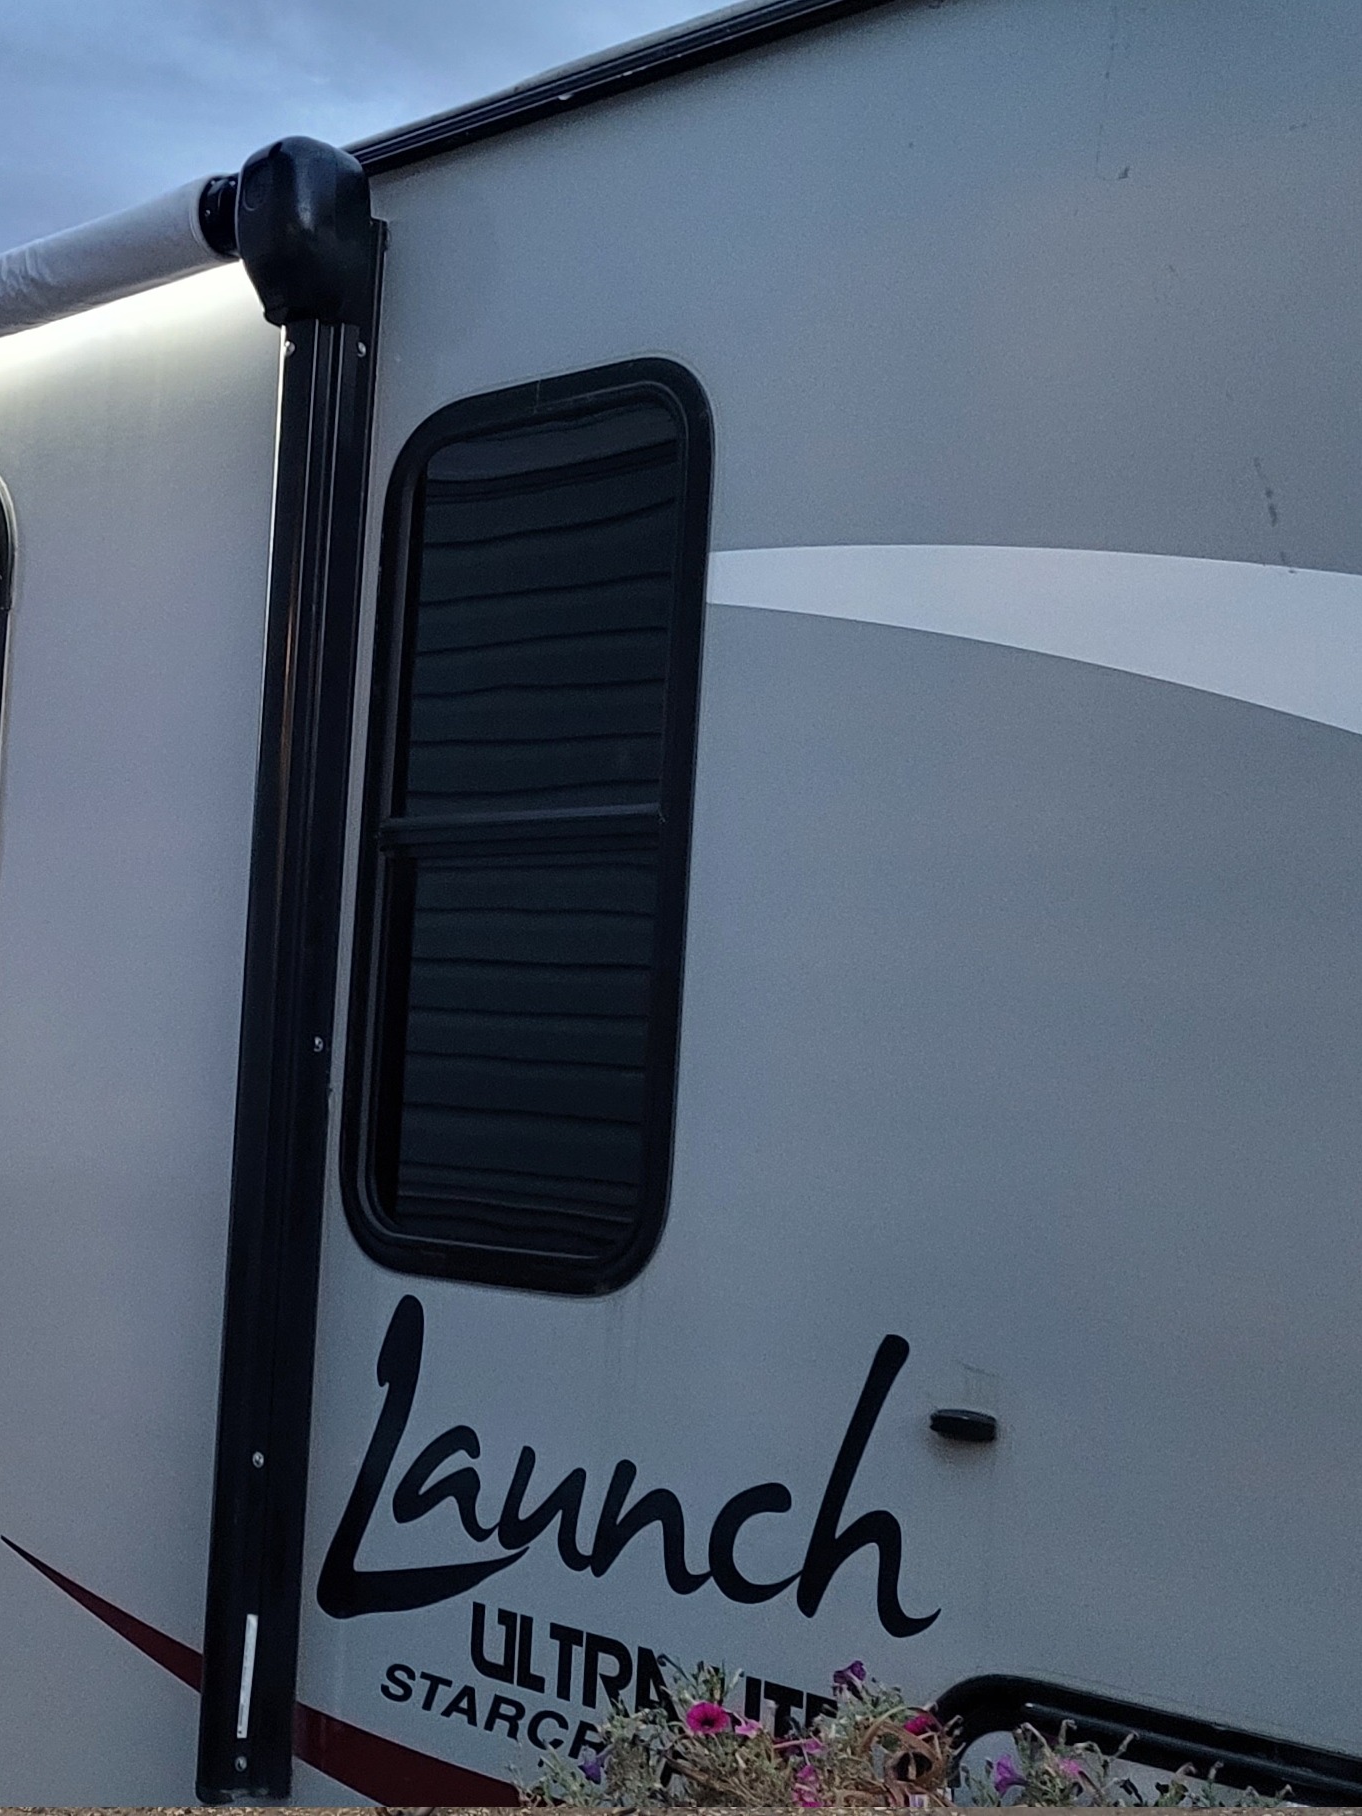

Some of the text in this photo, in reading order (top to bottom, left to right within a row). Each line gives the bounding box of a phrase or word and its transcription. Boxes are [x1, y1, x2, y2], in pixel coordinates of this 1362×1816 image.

[317, 1295, 941, 1638] Launch
[380, 1663, 672, 1787] STARCR
[470, 1601, 684, 1728] ULTRA
